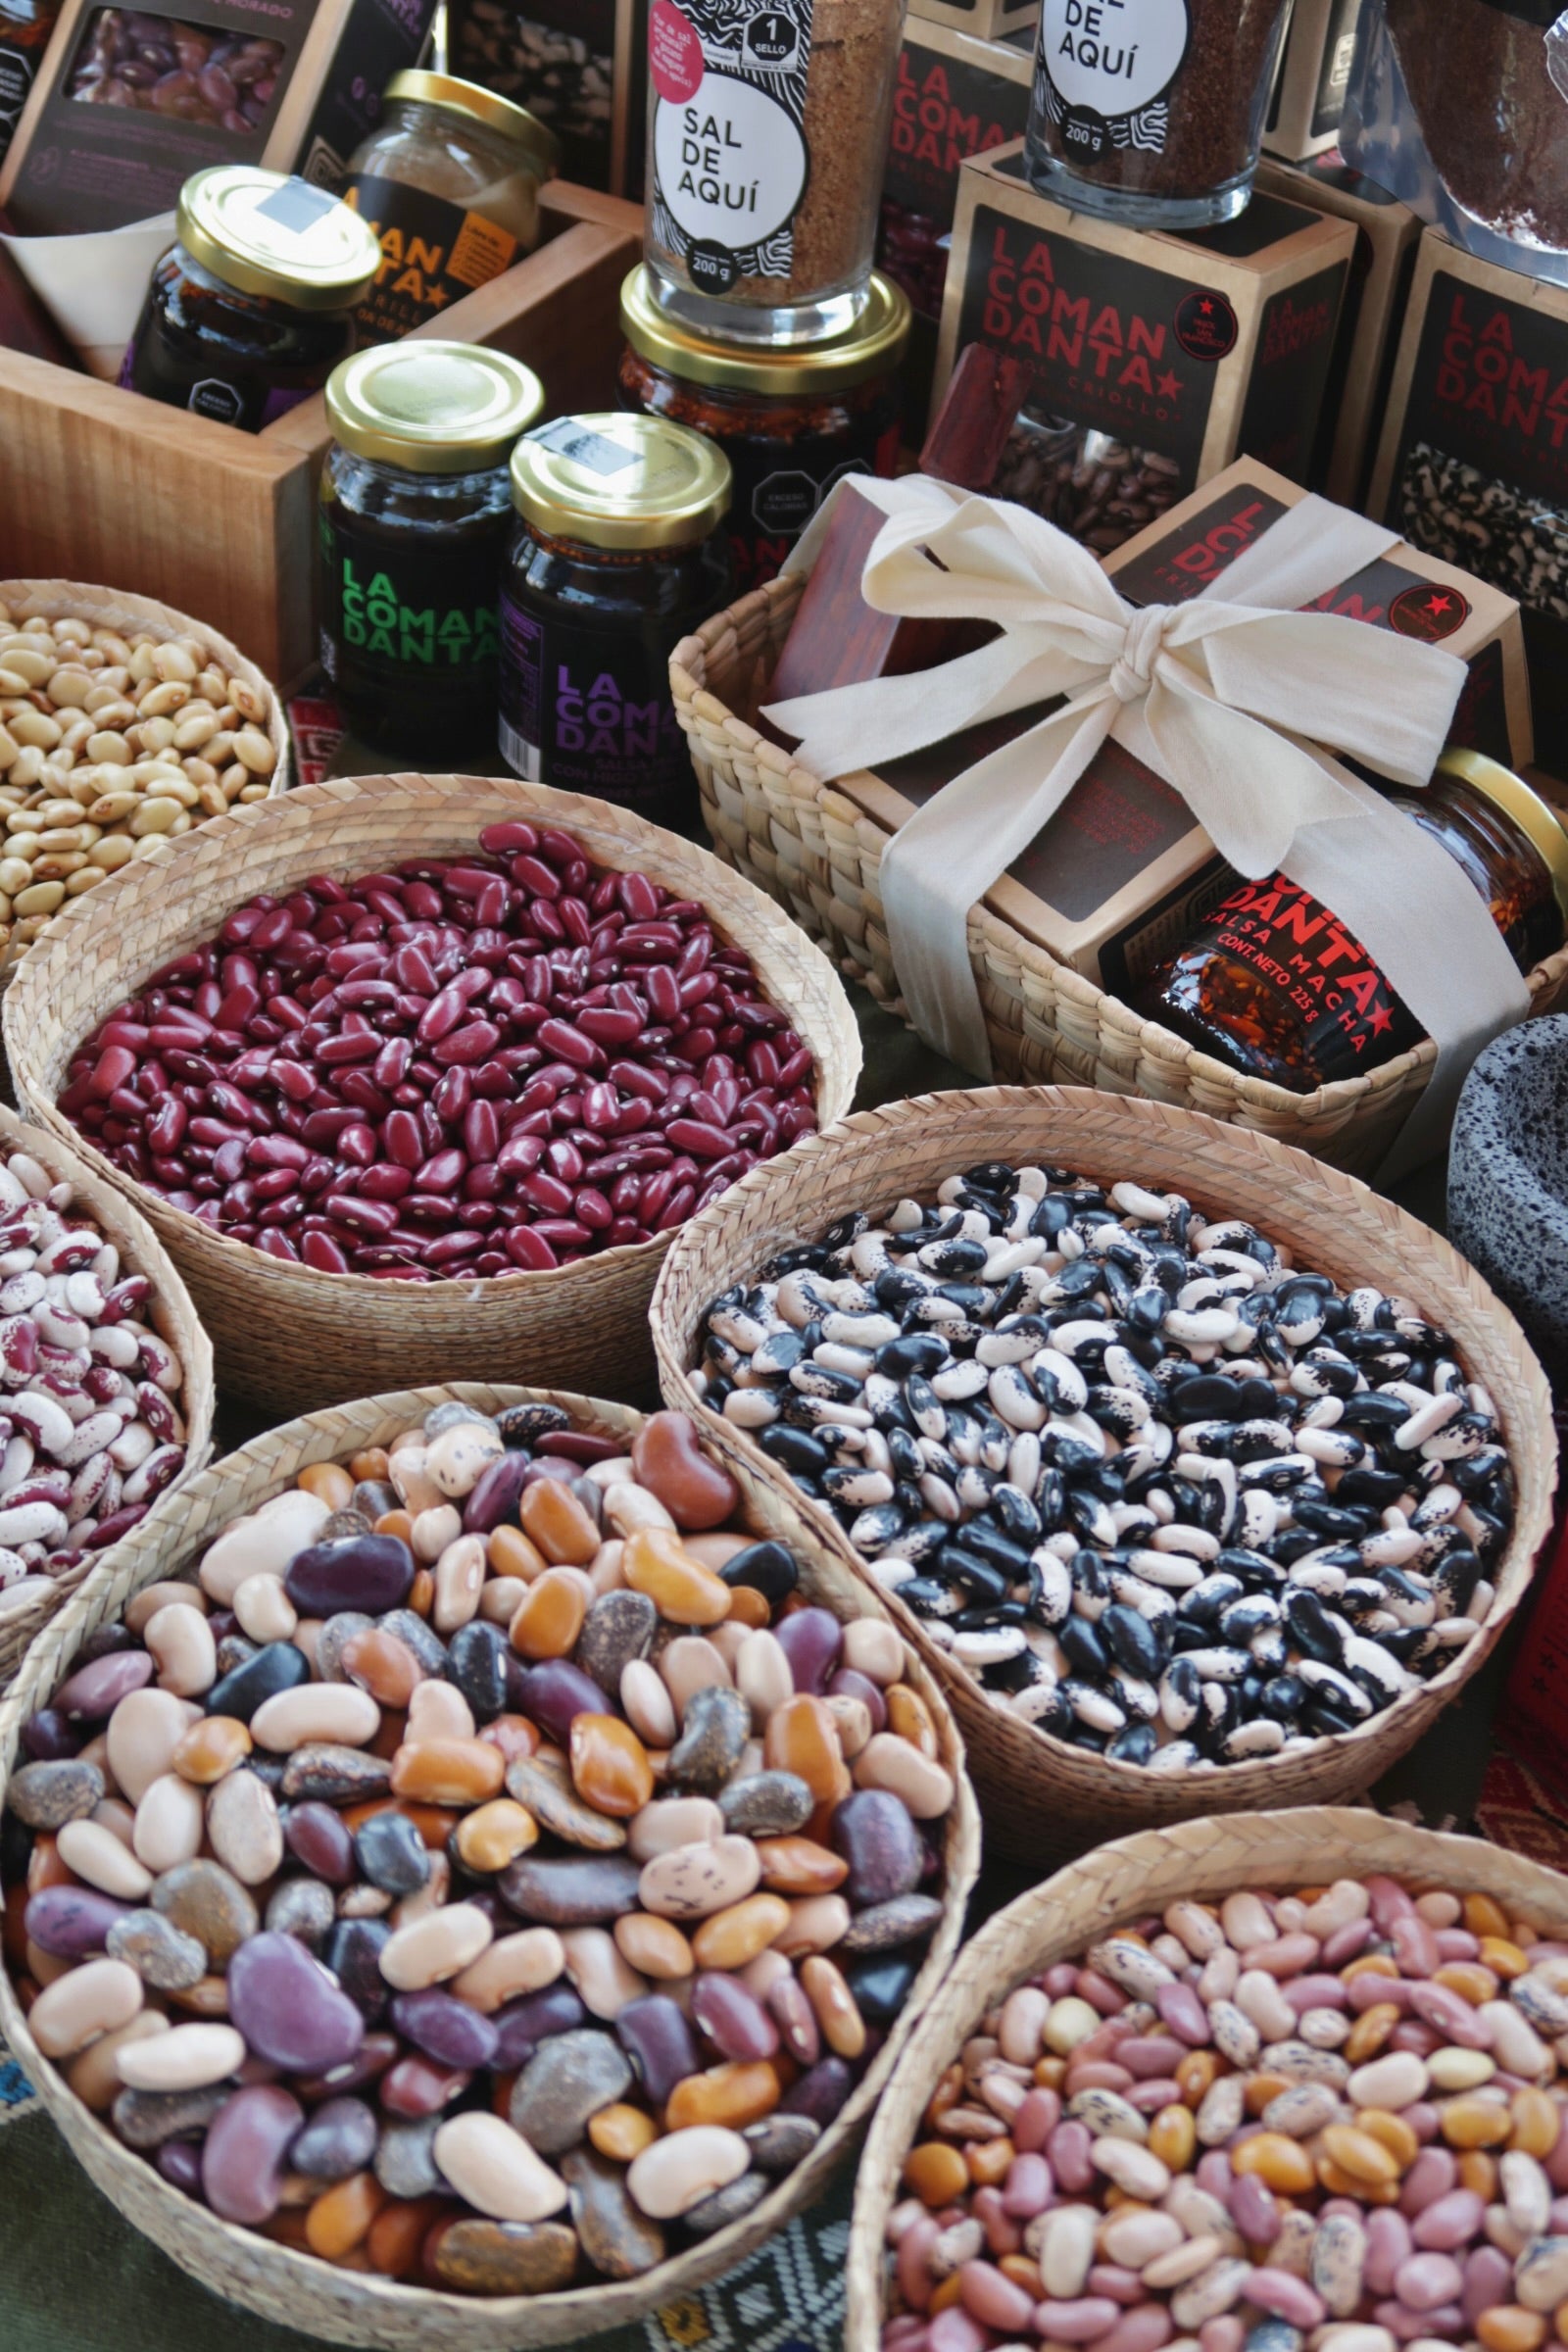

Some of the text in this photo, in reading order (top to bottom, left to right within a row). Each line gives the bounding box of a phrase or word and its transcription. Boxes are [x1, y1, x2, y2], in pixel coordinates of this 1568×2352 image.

[766, 19, 776, 40] 1
[1065, 0, 1102, 37] DE
[755, 43, 786, 55] SELLO
[1058, 30, 1140, 79] AQUÍ
[898, 51, 951, 103] LA
[683, 107, 742, 148] SAL
[894, 86, 1021, 154] COMA
[1065, 124, 1102, 151] 200 g
[682, 137, 720, 174] DE
[677, 169, 760, 213] AQUÍ
[369, 220, 444, 274] AN
[692, 257, 731, 282] 200 g
[993, 226, 1055, 283] LA
[987, 265, 1166, 361] COMAN
[1449, 294, 1513, 353] LA
[983, 298, 1153, 394] DANTA
[343, 557, 398, 606] LA
[558, 663, 622, 702] LA
[1220, 886, 1380, 1016] DANTA
[1201, 911, 1272, 945] SALSA
[1289, 953, 1367, 1054] MACHA
[1217, 932, 1320, 1024] CONT. NETO 225 g
